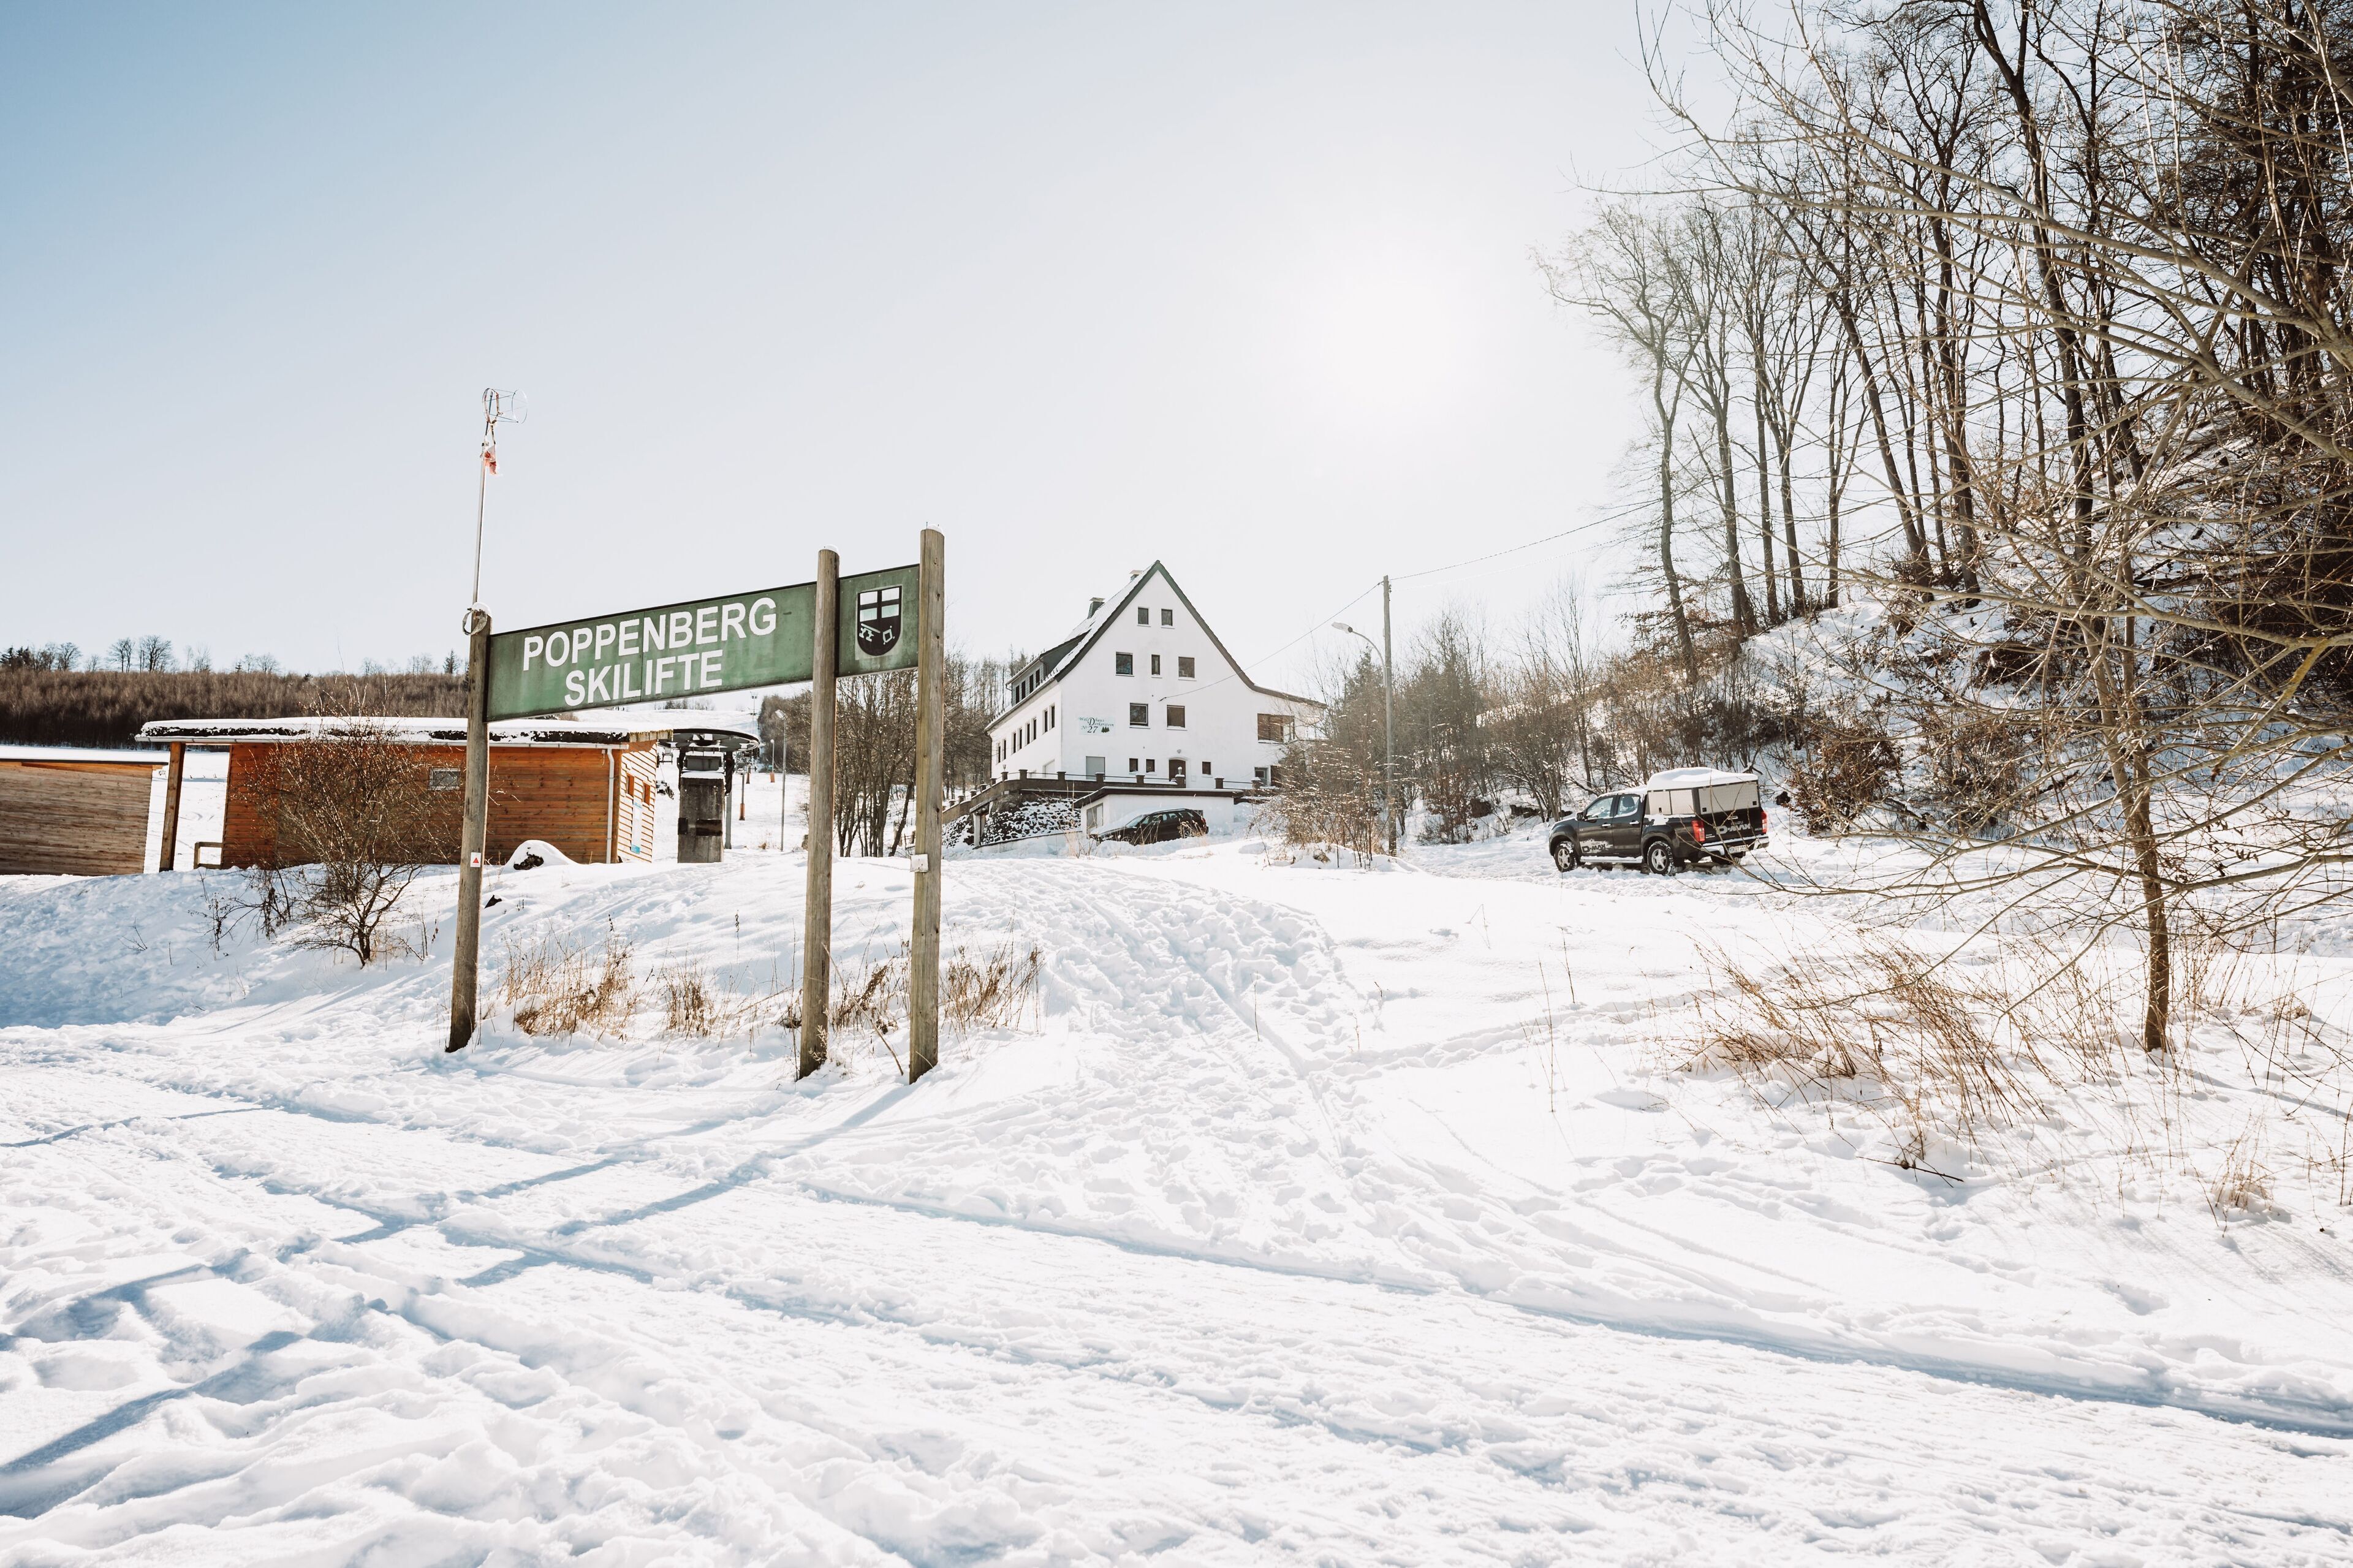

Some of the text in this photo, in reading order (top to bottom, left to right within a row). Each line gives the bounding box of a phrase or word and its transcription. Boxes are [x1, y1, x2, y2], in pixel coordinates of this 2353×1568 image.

[523, 597, 776, 671] POPPENBERG
[564, 649, 723, 706] SKILIFTE
[1582, 844, 1606, 852] D-MAX
